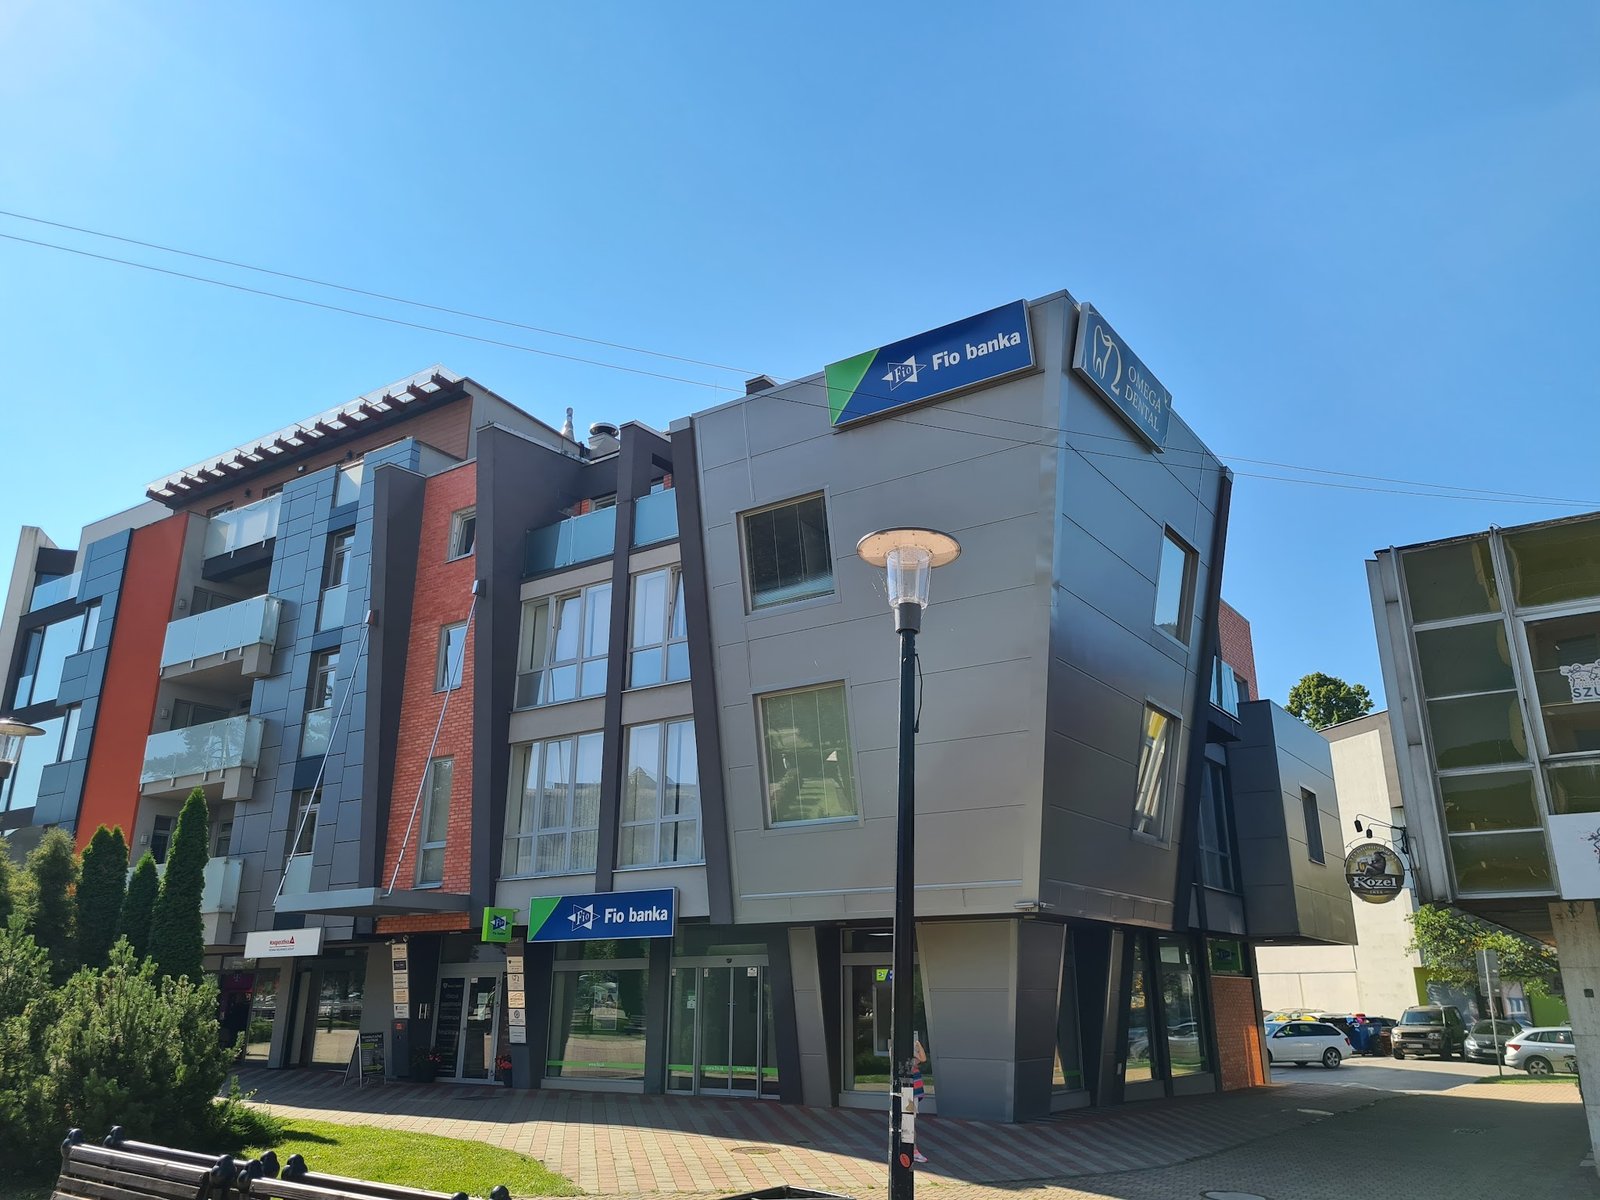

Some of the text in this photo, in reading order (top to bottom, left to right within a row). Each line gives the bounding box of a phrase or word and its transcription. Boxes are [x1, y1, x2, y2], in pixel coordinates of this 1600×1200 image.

[932, 331, 1021, 371] Fio banka
[894, 366, 912, 383] Fio
[1128, 366, 1161, 413] OMEGA
[1125, 384, 1159, 432] DENTAL
[1353, 876, 1397, 889] Kozel
[576, 910, 589, 925] Fio
[604, 906, 668, 924] Fio banka
